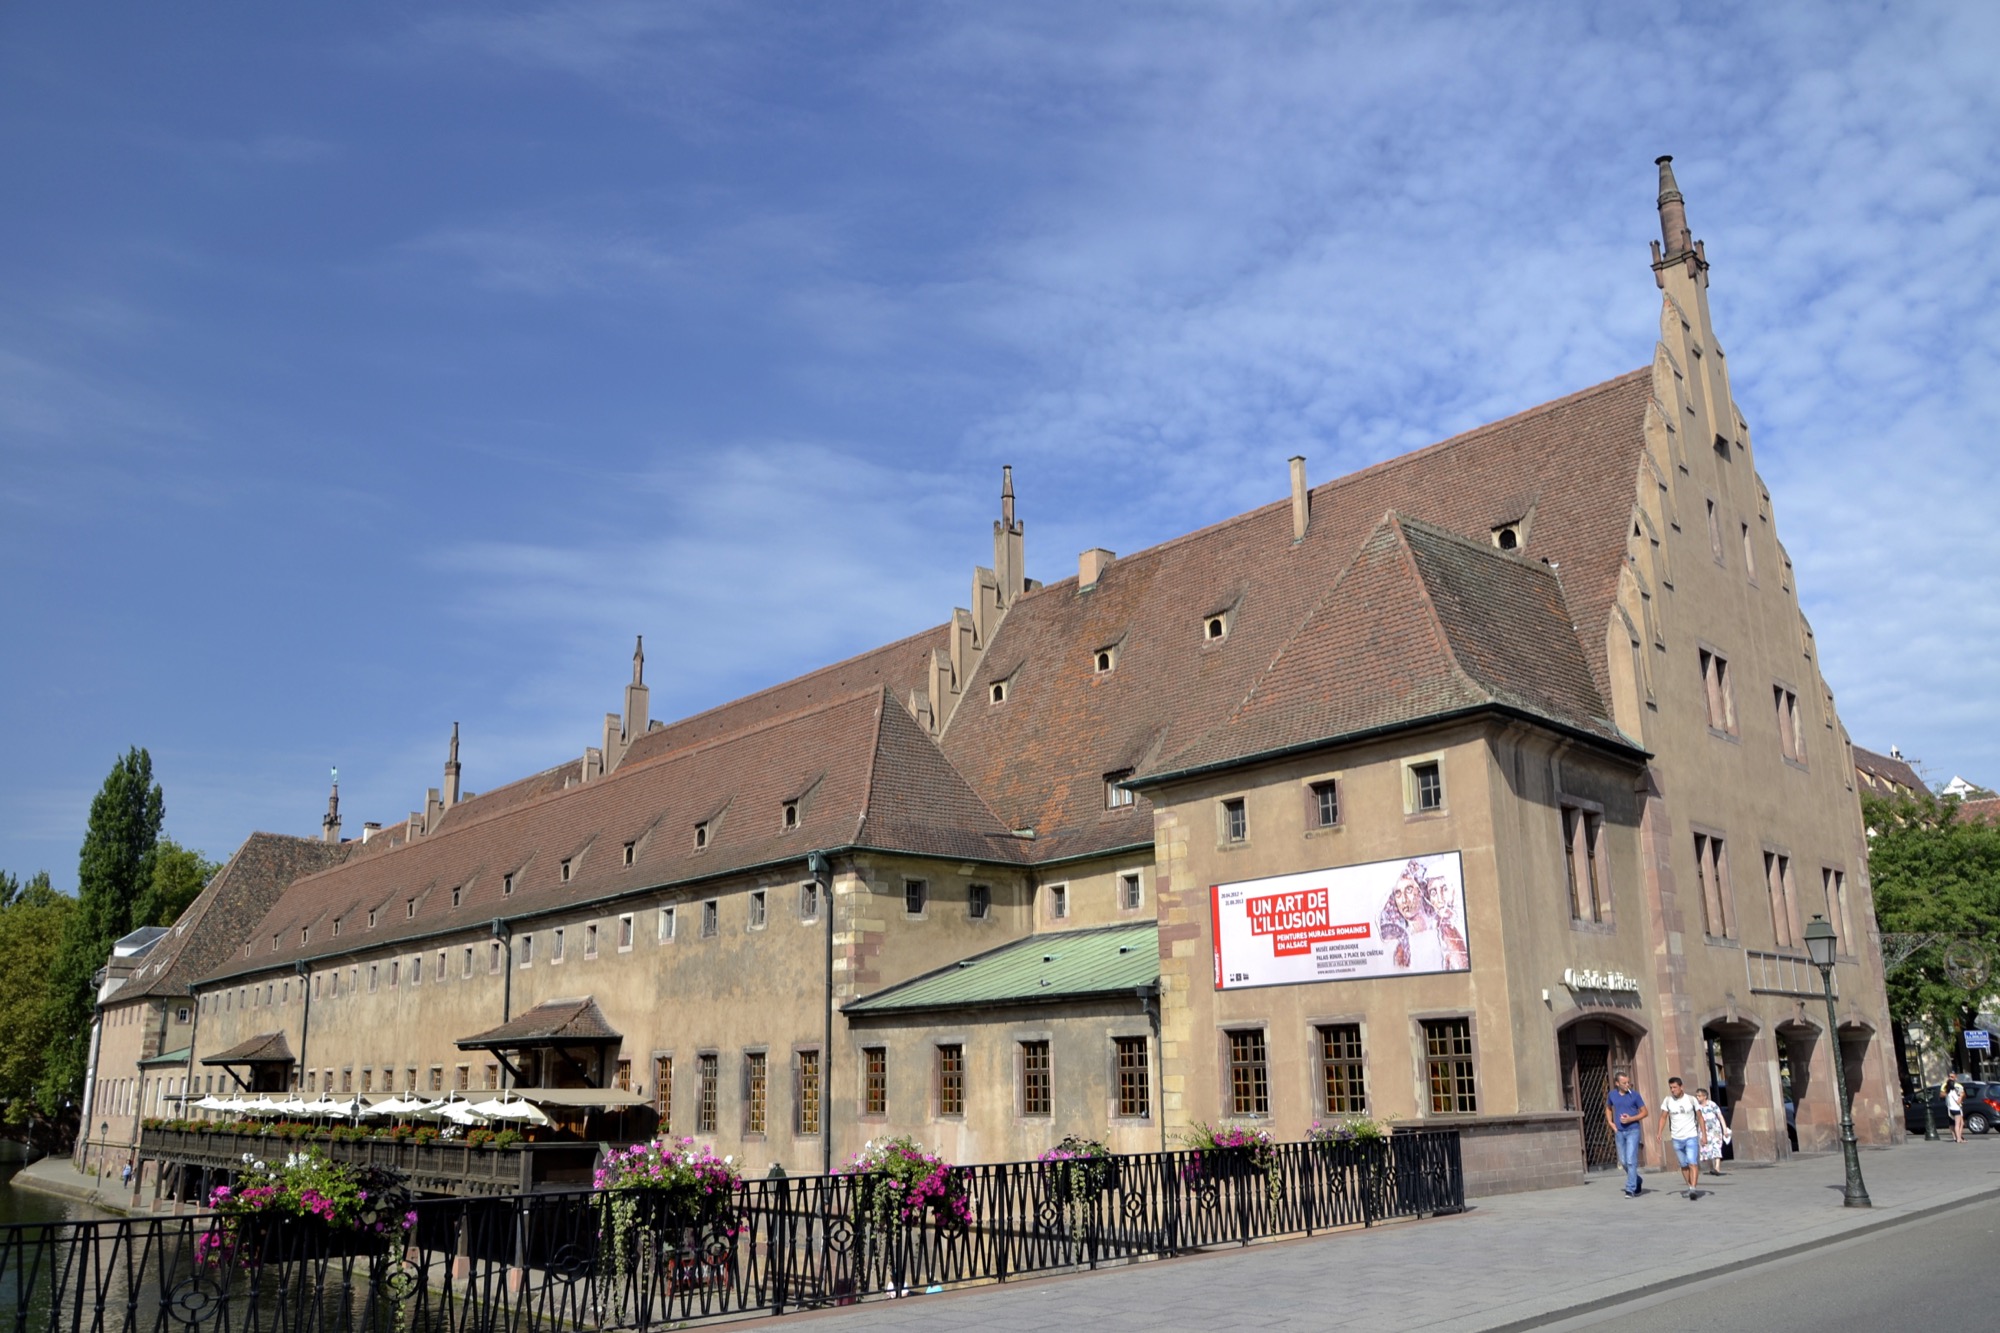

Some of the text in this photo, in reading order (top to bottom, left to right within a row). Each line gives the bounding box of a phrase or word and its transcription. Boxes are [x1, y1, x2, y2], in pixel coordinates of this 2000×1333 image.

[1253, 891, 1327, 915] UN ART DE
[1253, 909, 1327, 933] L'ILLUSION
[1277, 925, 1367, 941] PEINTURES MURALES ROMAINES
[1277, 940, 1308, 950] EN ALSACE
